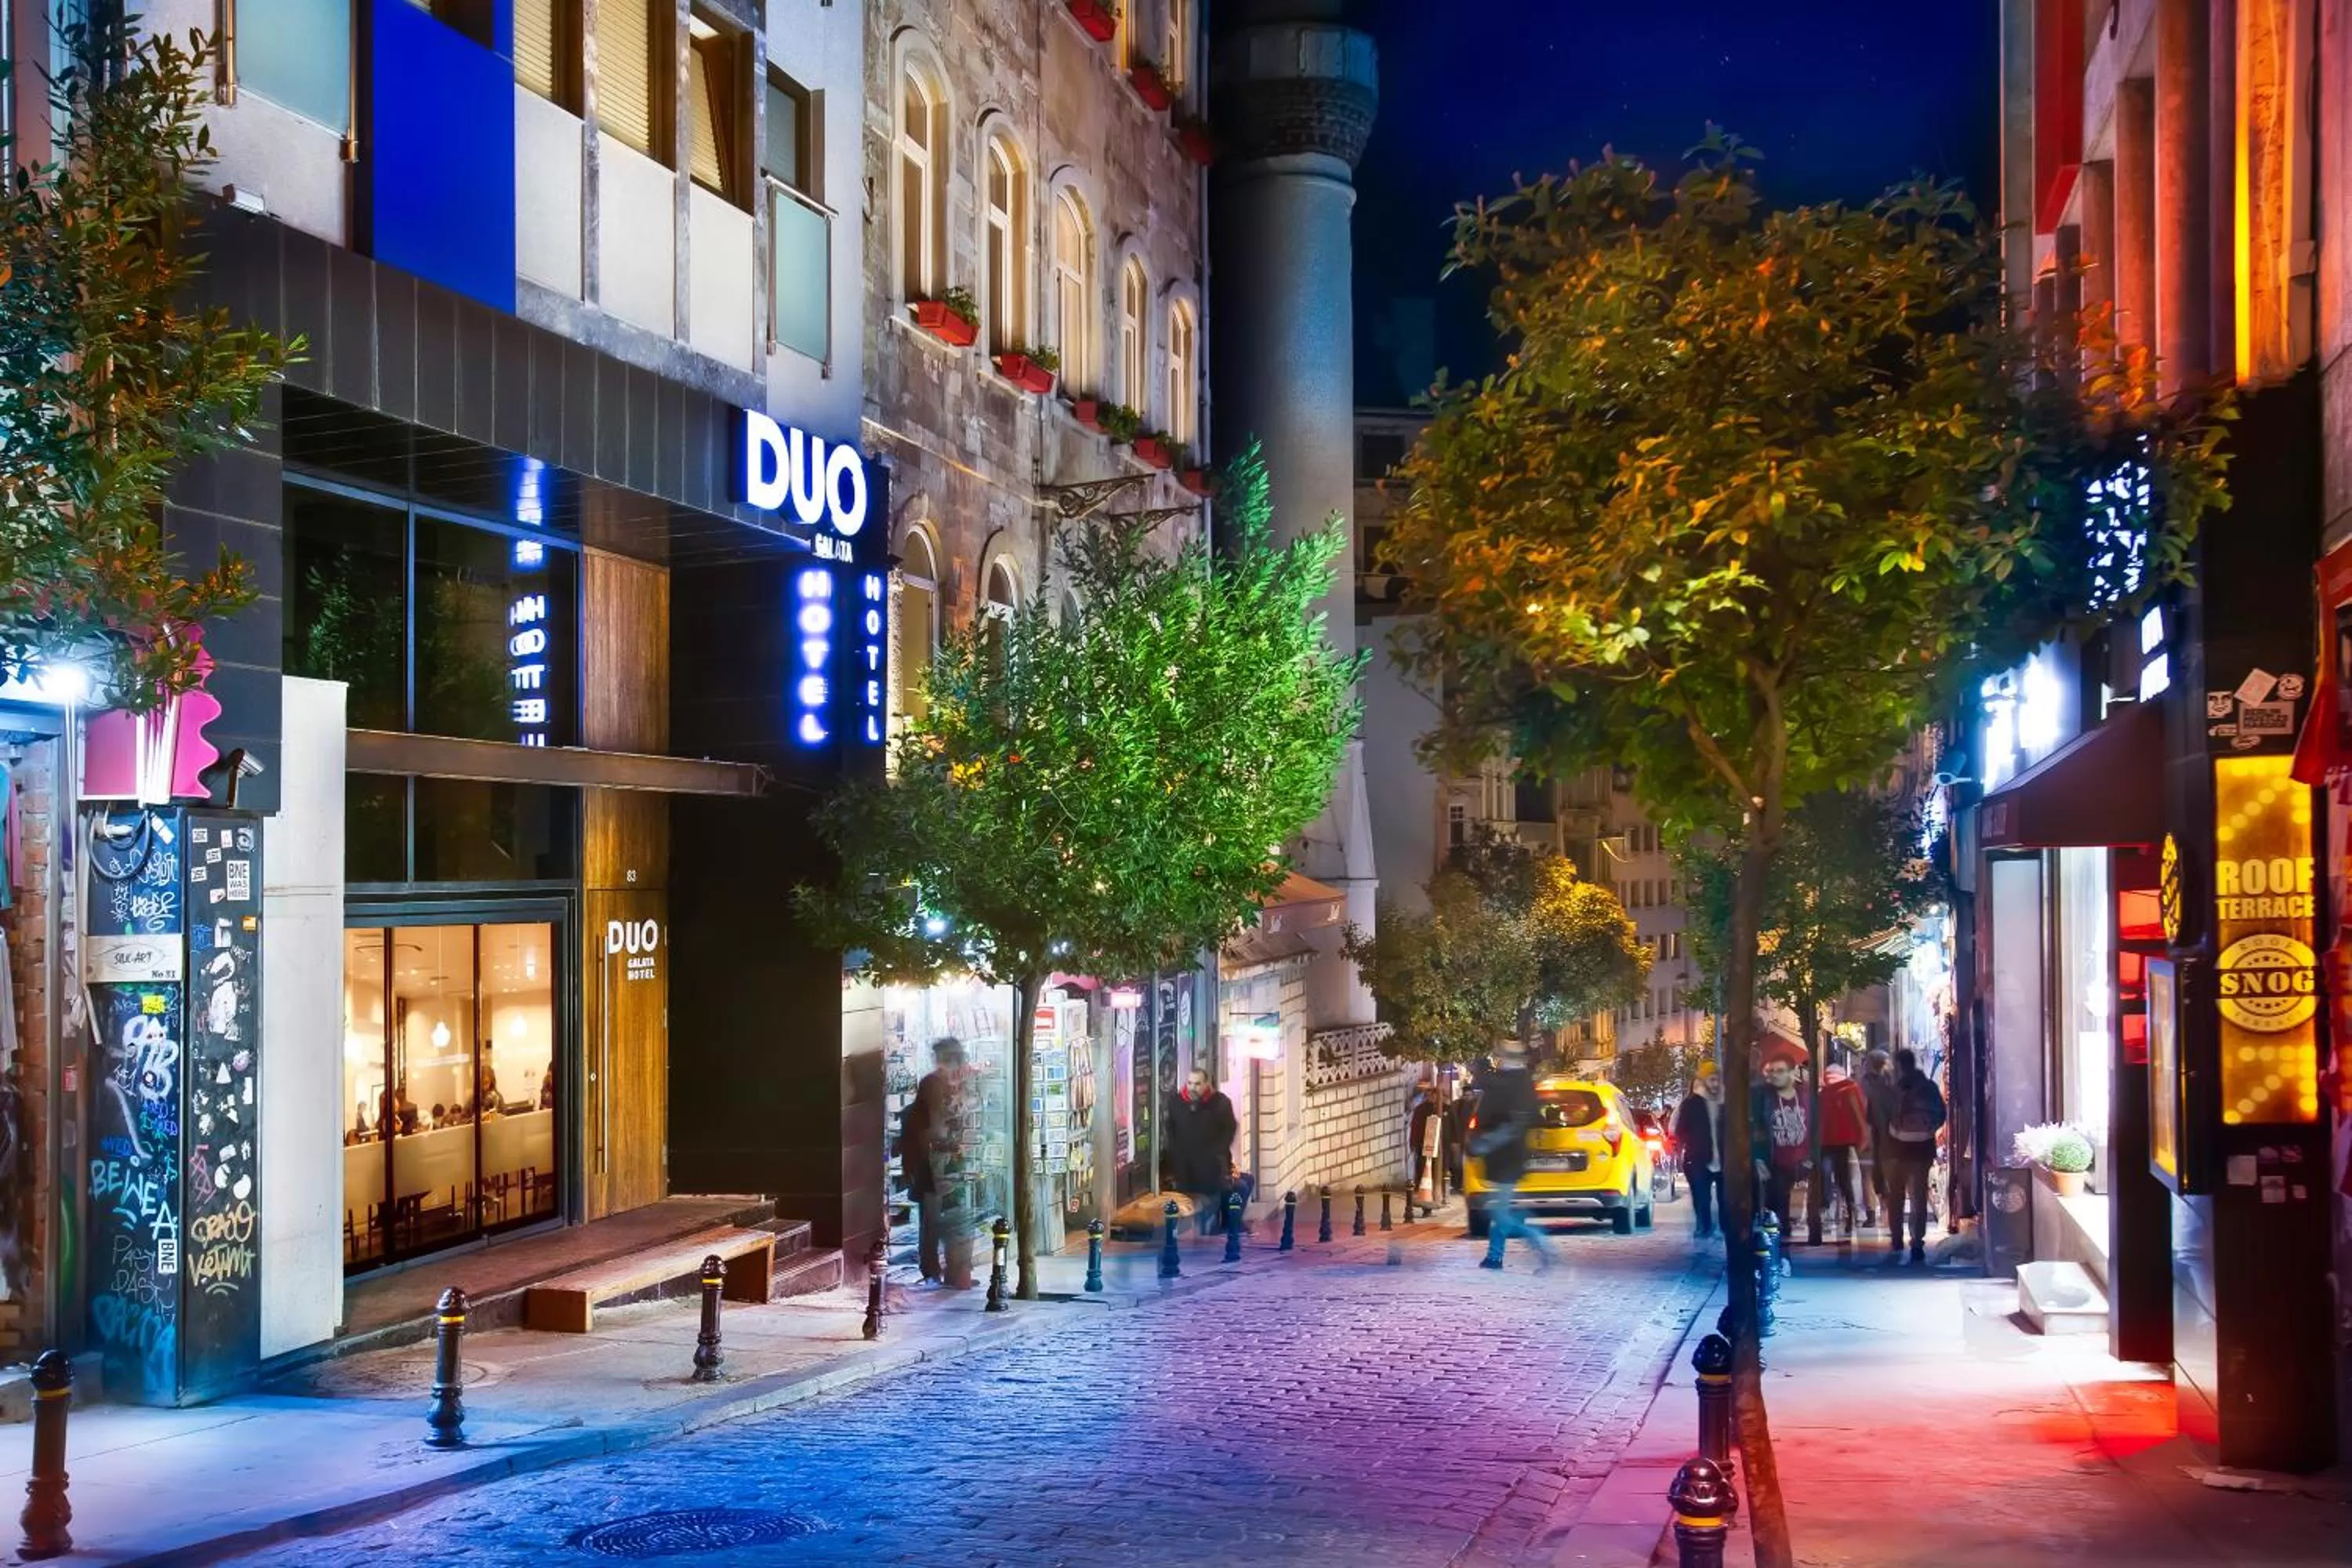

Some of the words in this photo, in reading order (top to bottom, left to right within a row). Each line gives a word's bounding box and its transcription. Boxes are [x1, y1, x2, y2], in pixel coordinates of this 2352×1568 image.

[746, 408, 867, 536] DUO
[815, 532, 854, 564] GALATA
[798, 569, 832, 743] HOTEL
[866, 575, 880, 742] HOTEL
[228, 862, 249, 879] BNE
[2216, 857, 2315, 895] ROOF
[228, 889, 249, 898] HERE
[2215, 895, 2315, 920] TERRACE
[607, 918, 659, 954] DUO
[627, 969, 655, 981] HOTEL
[2220, 969, 2315, 995] SNOG
[160, 1241, 176, 1271] BNE
